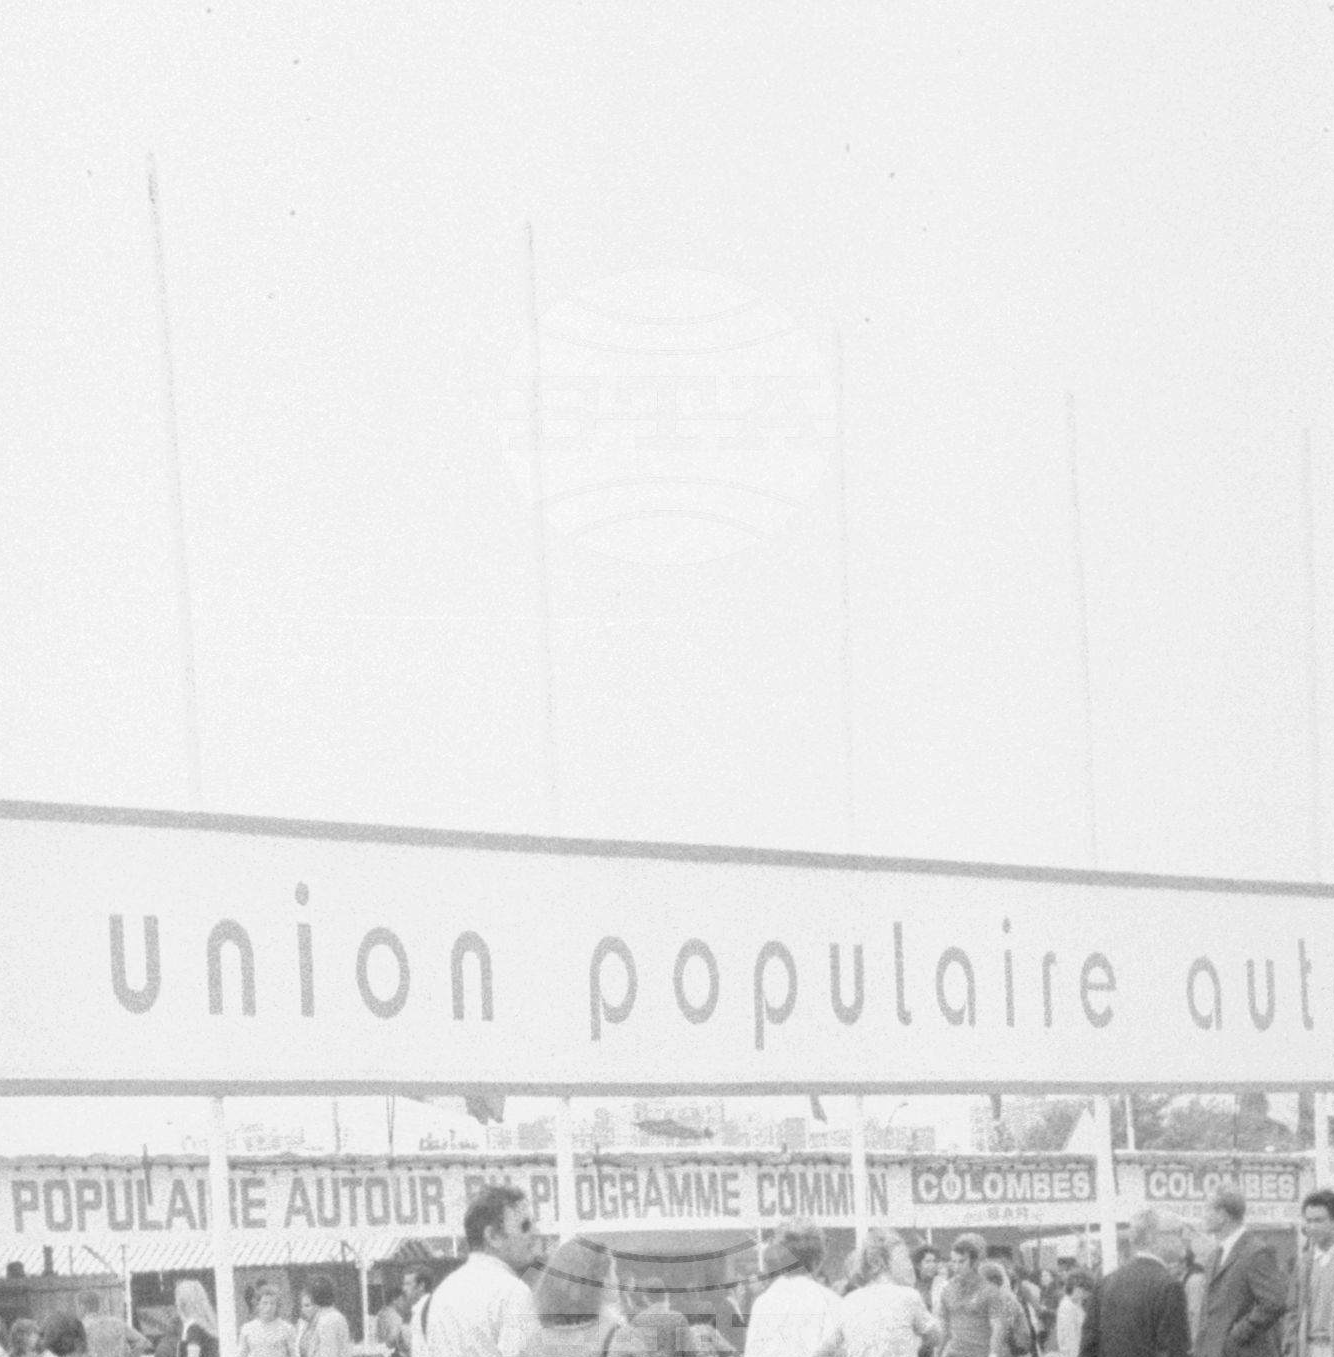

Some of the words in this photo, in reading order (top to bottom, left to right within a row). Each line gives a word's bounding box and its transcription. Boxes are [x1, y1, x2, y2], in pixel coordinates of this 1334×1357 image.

[108, 881, 495, 1021] union
[589, 917, 1118, 1050] populaire
[283, 1174, 446, 1229] AUTOUR
[531, 1172, 741, 1222] POGRAMME
[757, 1171, 888, 1217] COMMN
[917, 1170, 1092, 1201] COLOMBES
